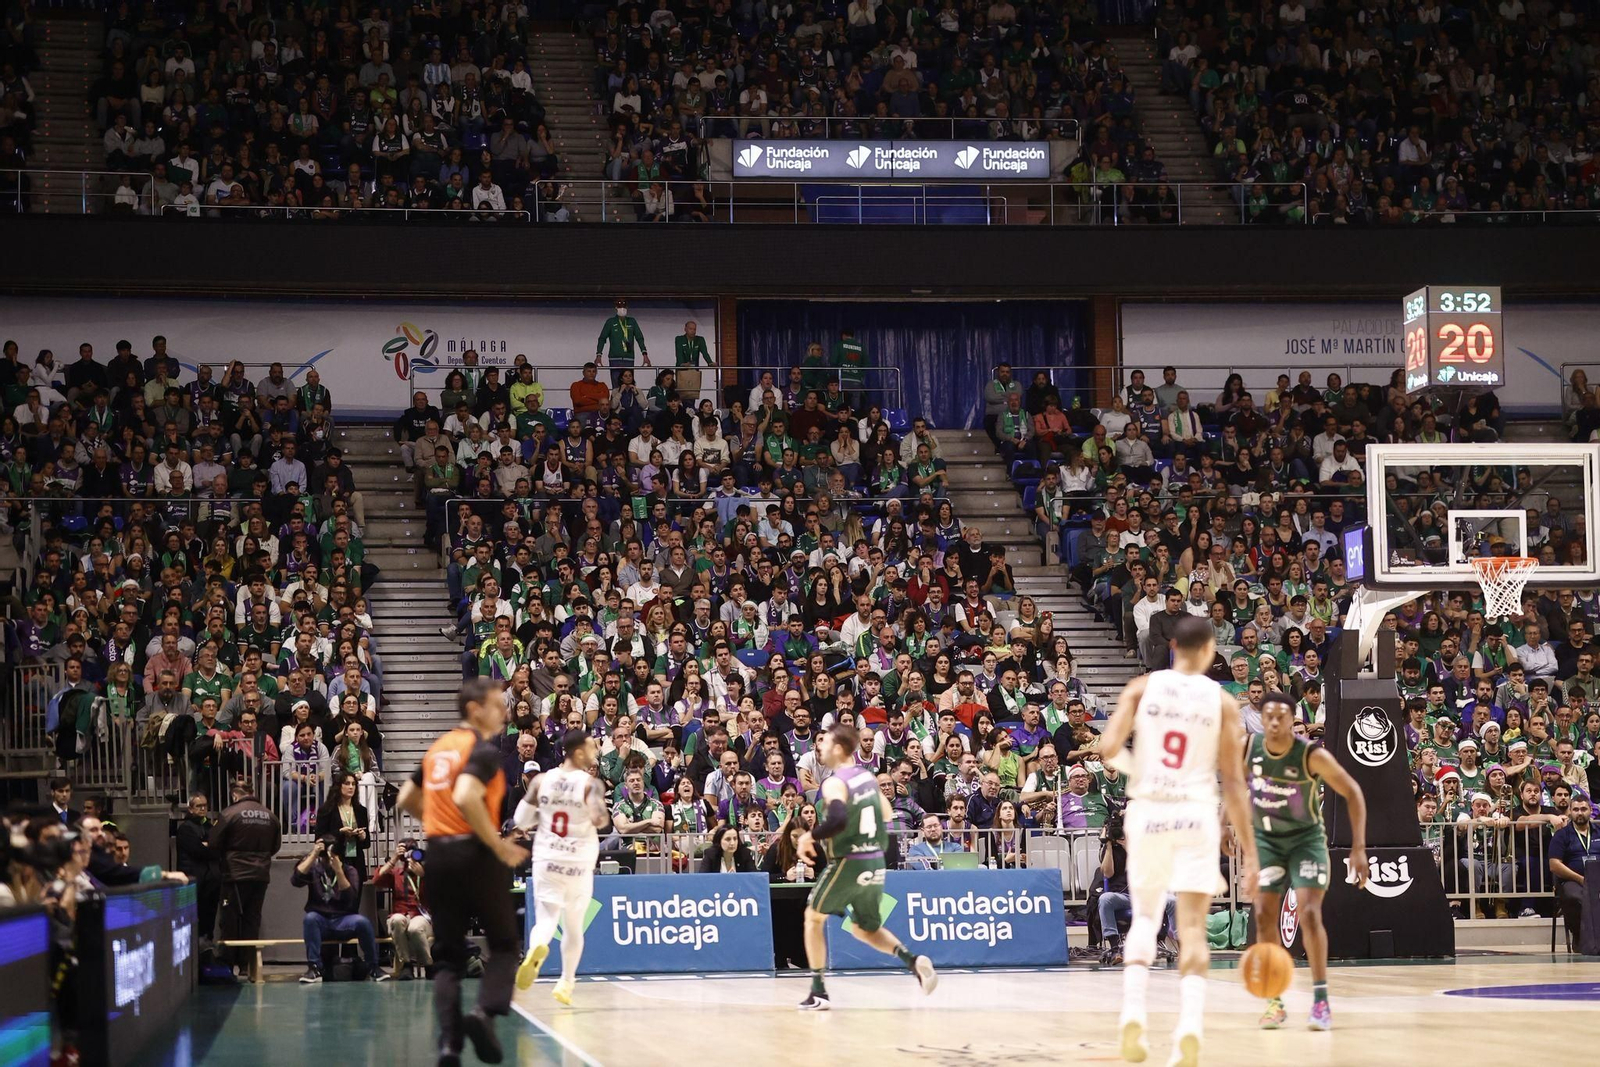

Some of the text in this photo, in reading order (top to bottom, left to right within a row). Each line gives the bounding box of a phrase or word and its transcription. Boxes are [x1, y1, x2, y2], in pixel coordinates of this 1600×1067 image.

[766, 146, 829, 158] Fundación
[874, 147, 938, 159] Fundación
[983, 148, 1045, 159] Fundación
[766, 158, 812, 172] Unicaja
[874, 159, 921, 173] Unicaja
[983, 159, 1028, 174] Unicaja
[1440, 293, 1491, 312] 3:52
[1332, 319, 1400, 335] PALACIO DE
[447, 337, 507, 352] MÁLAGA
[1285, 335, 1316, 355] JOSÉ
[1321, 338, 1339, 354] Mª
[1344, 335, 1395, 354] MARTÍN
[1407, 327, 1426, 371] 20
[1438, 323, 1494, 363] 20
[481, 355, 507, 365] Eventos
[1457, 370, 1499, 385] Unicaja
[1161, 730, 1188, 770] 9
[1355, 739, 1389, 756] Risi
[241, 809, 270, 819] COFER
[859, 805, 877, 838] 4
[551, 811, 569, 838] 0
[611, 892, 759, 920] Fundación
[906, 889, 1051, 916] Fundación
[612, 919, 719, 951] Unicaja
[908, 915, 1013, 947] Unicaja
